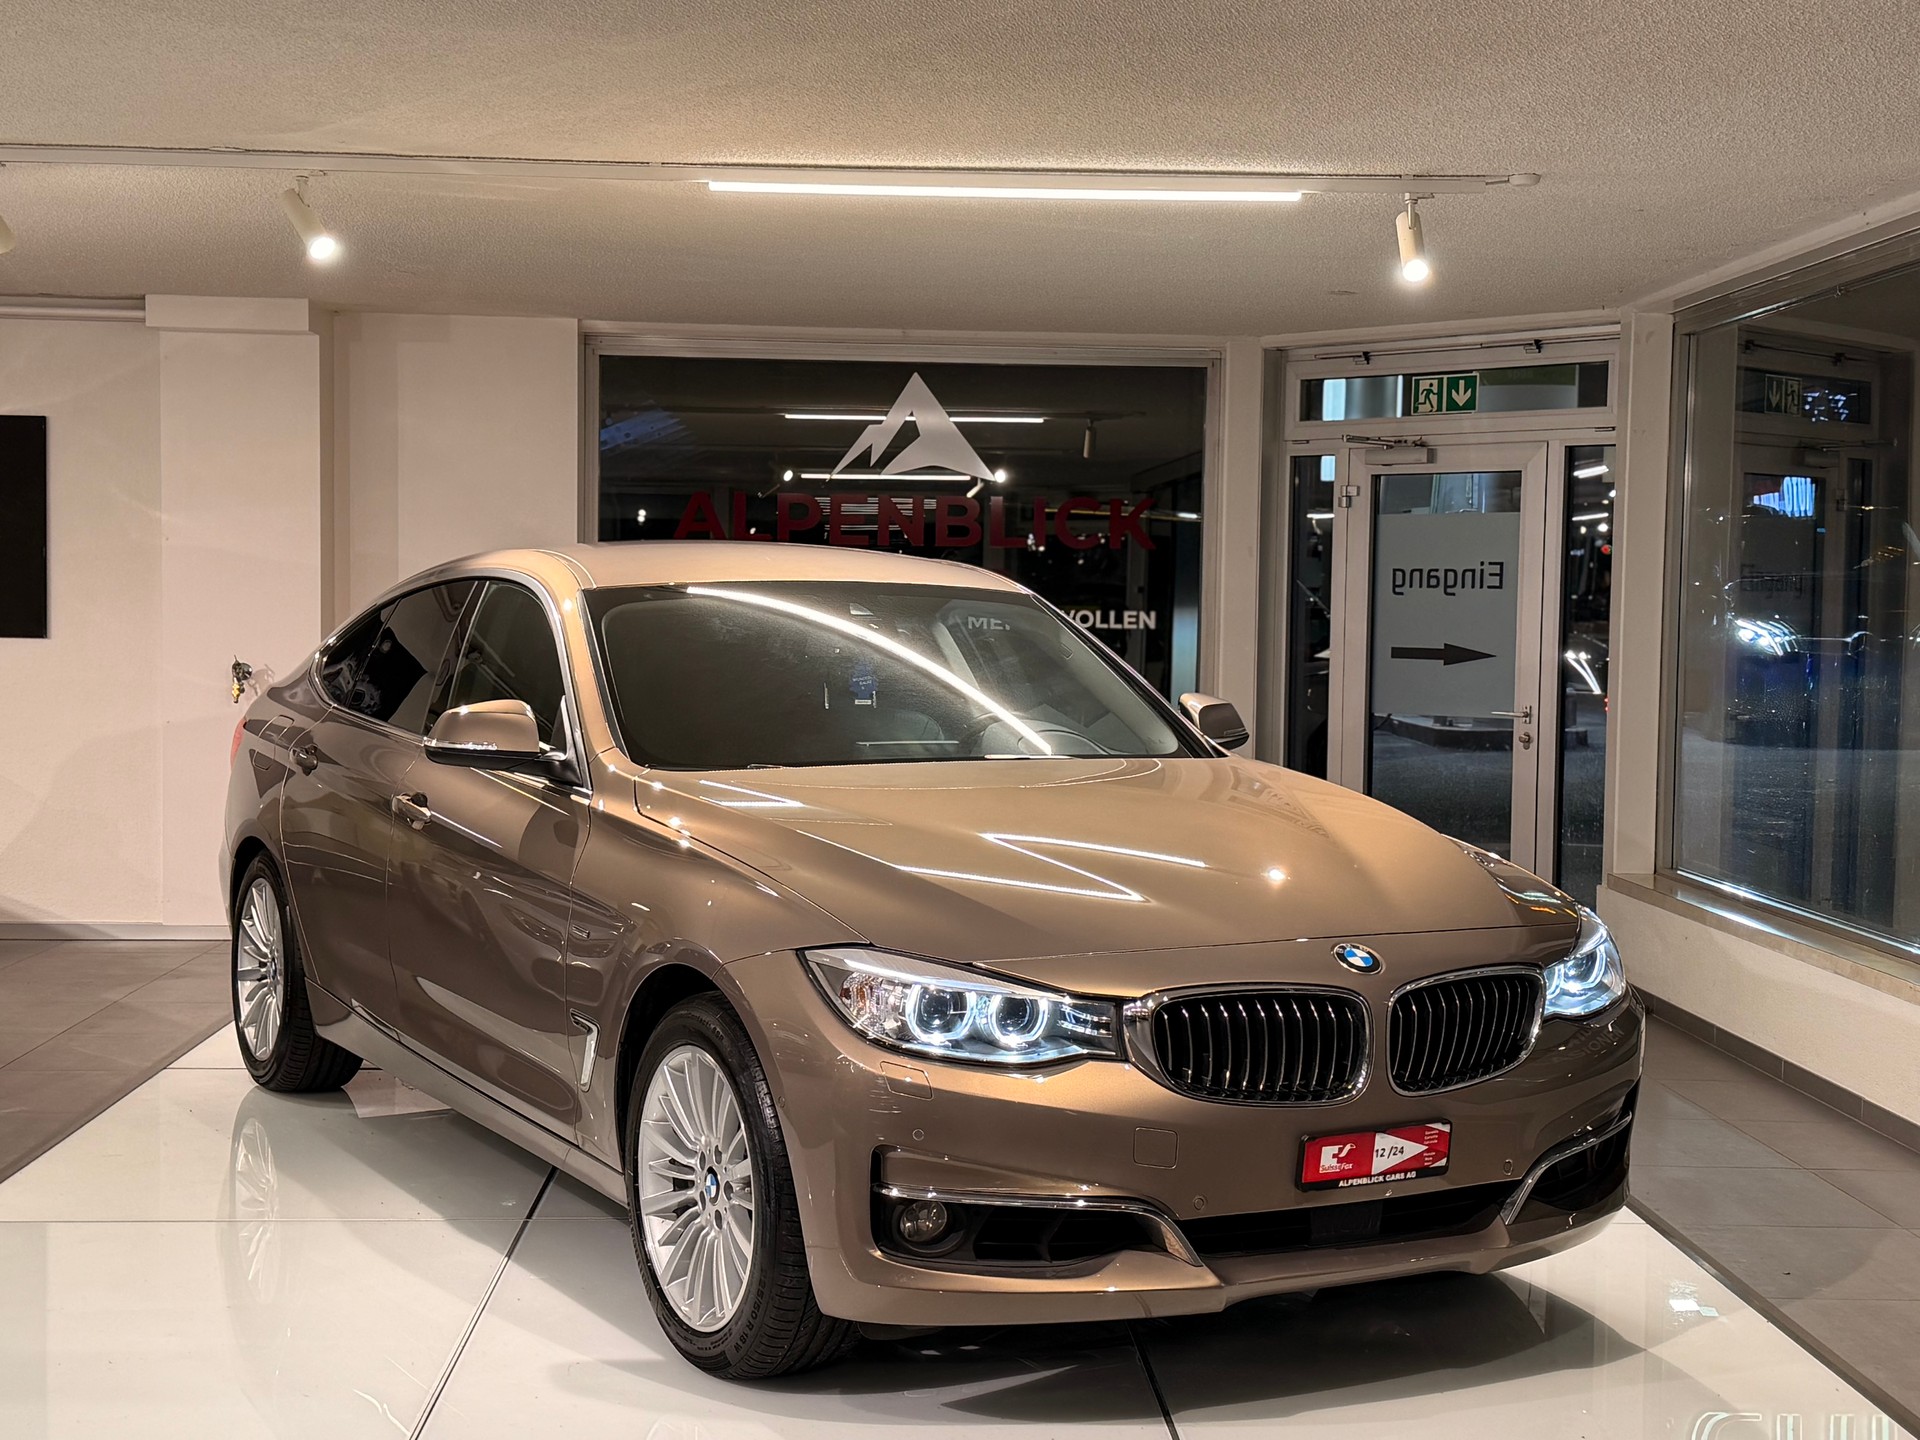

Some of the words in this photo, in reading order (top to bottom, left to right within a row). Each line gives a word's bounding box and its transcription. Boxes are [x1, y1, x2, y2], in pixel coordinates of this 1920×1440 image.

[673, 490, 1156, 549] ALPENBLICK
[967, 616, 1011, 631] ME
[1338, 1175, 1384, 1187] ALPENBLICK
[1385, 1172, 1405, 1182] CARS
[1406, 1171, 1416, 1179] AG
